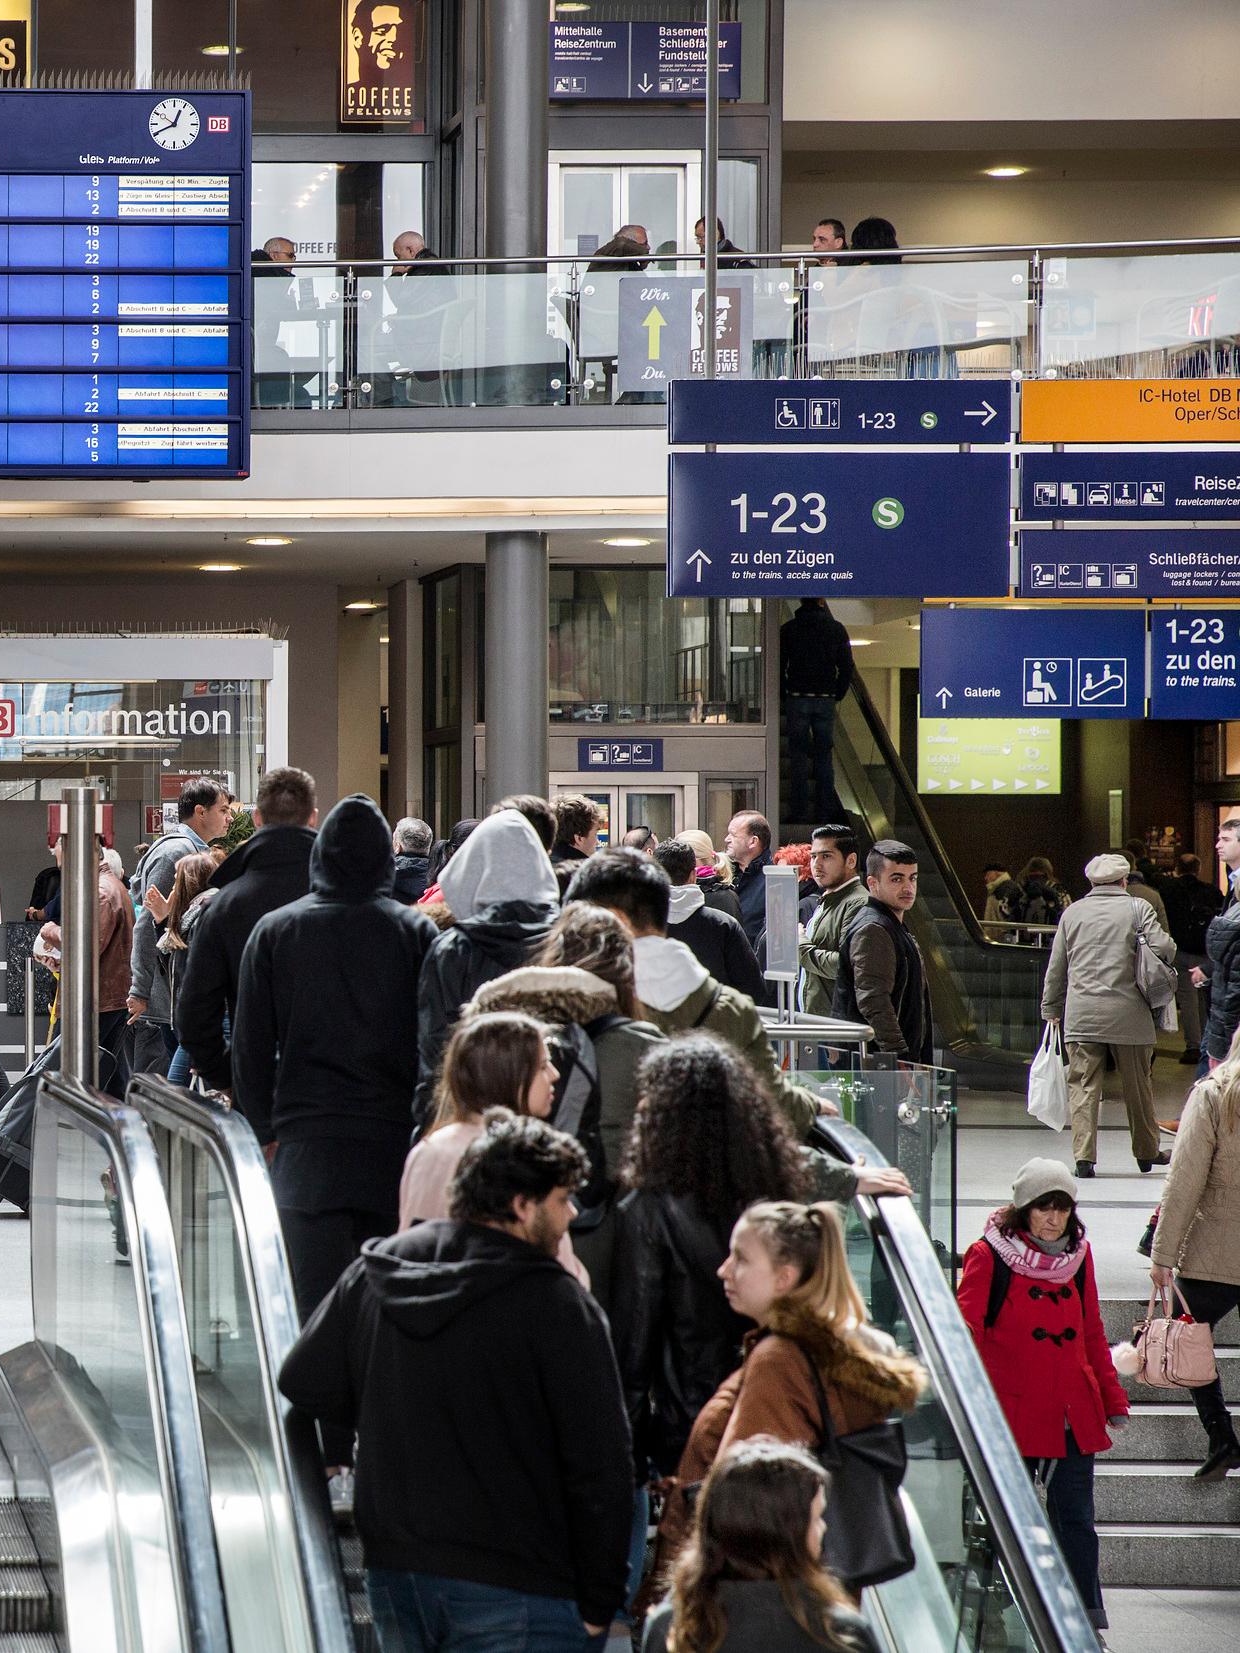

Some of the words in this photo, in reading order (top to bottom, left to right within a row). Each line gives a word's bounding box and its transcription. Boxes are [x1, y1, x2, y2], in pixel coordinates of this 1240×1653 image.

[554, 26, 603, 36] Mittelhalle
[659, 26, 708, 36] Basement
[554, 39, 617, 49] ReiseZentrum
[659, 38, 728, 49] Schließfäer
[347, 87, 412, 107] COFFEE
[348, 108, 412, 116] FELLOWS
[209, 118, 228, 131] DB
[92, 176, 99, 186] 9
[85, 253, 99, 264] 22
[640, 287, 670, 301] Wir.
[692, 350, 738, 363] CFEE
[641, 366, 666, 379] Du.
[692, 362, 738, 372] FEOWS
[1139, 388, 1201, 403] IC-Hotel
[1209, 388, 1232, 402] DB
[858, 412, 896, 429] 1-23
[1115, 497, 1136, 505] Messe
[730, 492, 827, 534] 1-23
[730, 553, 748, 564] zu
[753, 550, 781, 564] den
[786, 550, 835, 567] Zügen
[742, 571, 756, 579] the
[786, 570, 811, 579] accès
[831, 571, 853, 580] quais
[1163, 571, 1192, 580] luggage
[1165, 618, 1225, 644] 1-23
[1166, 655, 1190, 669] zu
[1197, 651, 1236, 669] den
[1180, 675, 1199, 686] the
[964, 687, 1001, 698] Galerie
